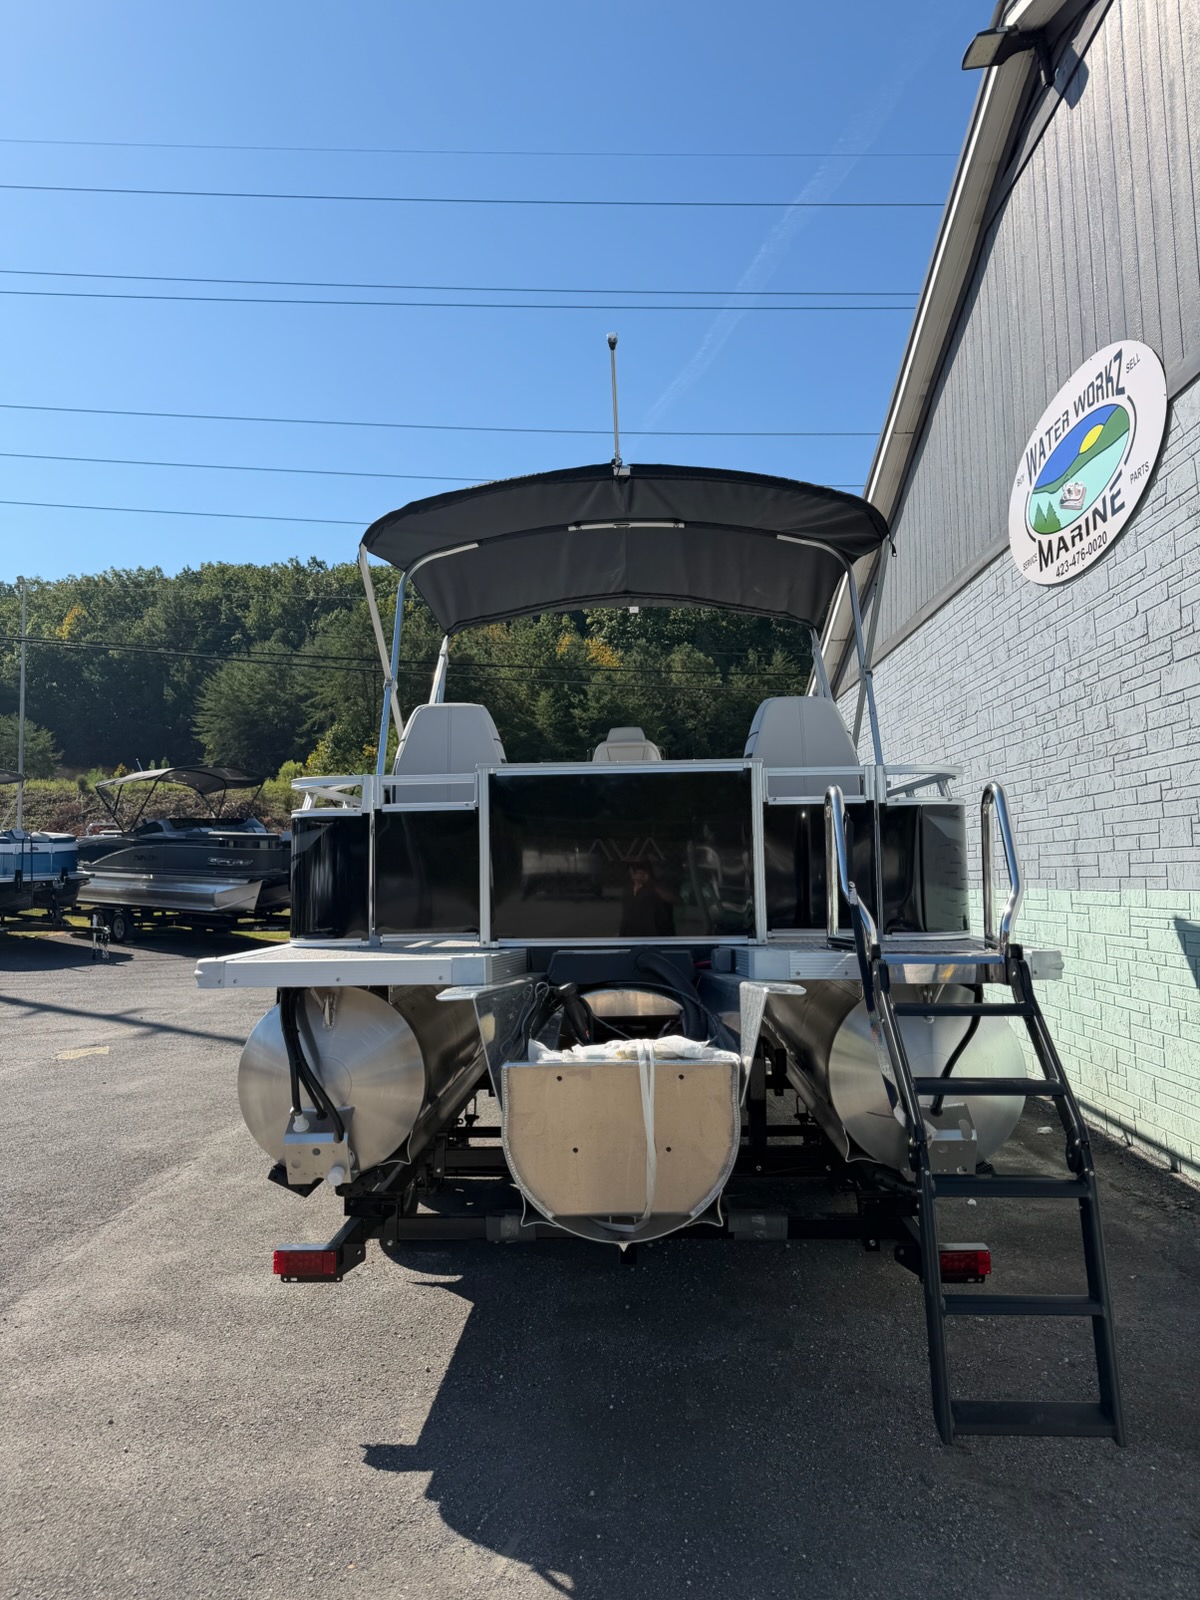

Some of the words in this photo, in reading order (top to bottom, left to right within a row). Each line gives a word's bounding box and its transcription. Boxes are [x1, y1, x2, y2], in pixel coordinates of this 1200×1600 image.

[1125, 352, 1141, 374] SELL
[1025, 409, 1070, 488] WATER
[1073, 347, 1126, 420] WORKZ
[1129, 460, 1150, 485] PARTS
[1037, 469, 1126, 573] MARINE
[1022, 552, 1038, 572] SERVICE
[1055, 530, 1108, 578] 423-476-0020
